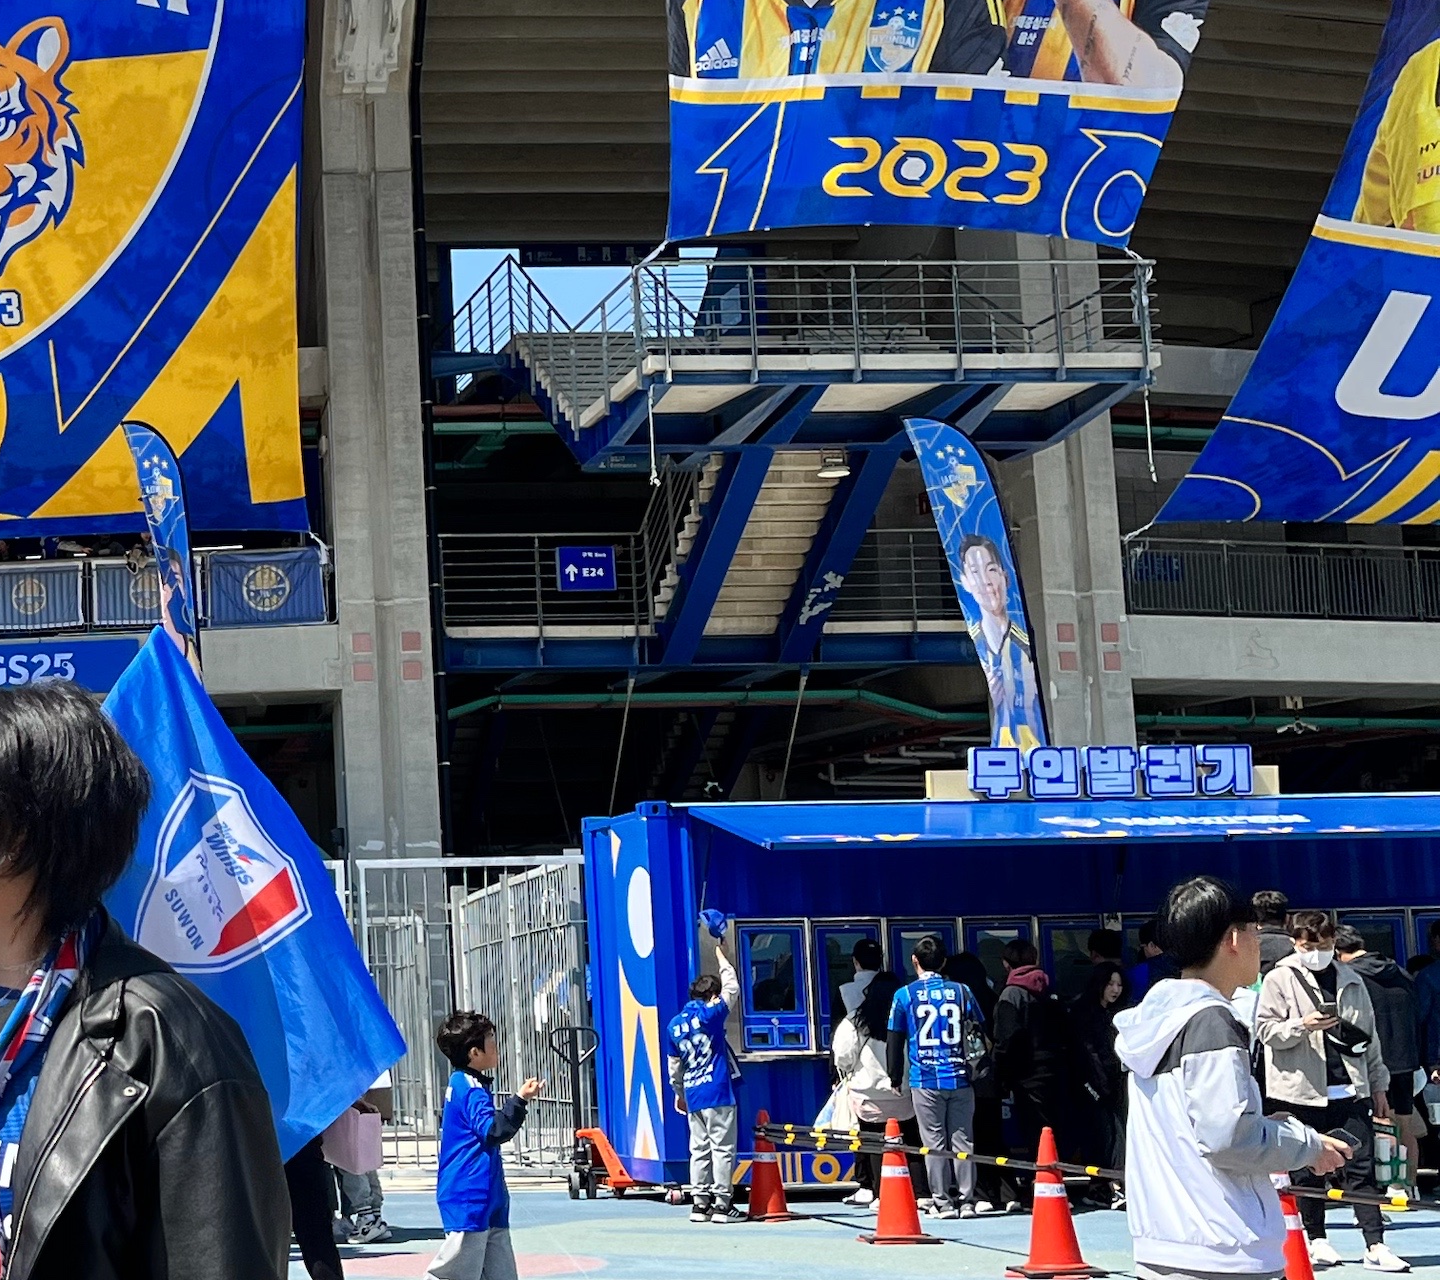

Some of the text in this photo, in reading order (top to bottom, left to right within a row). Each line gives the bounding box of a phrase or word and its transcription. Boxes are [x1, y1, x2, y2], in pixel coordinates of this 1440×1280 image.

[695, 57, 739, 71] adidas
[823, 137, 1049, 205] 2023
[582, 567, 604, 578] E24
[968, 745, 1253, 799] 무인발권기
[205, 832, 254, 886] Wings
[165, 888, 205, 951] SUWON
[916, 1003, 962, 1047] 23
